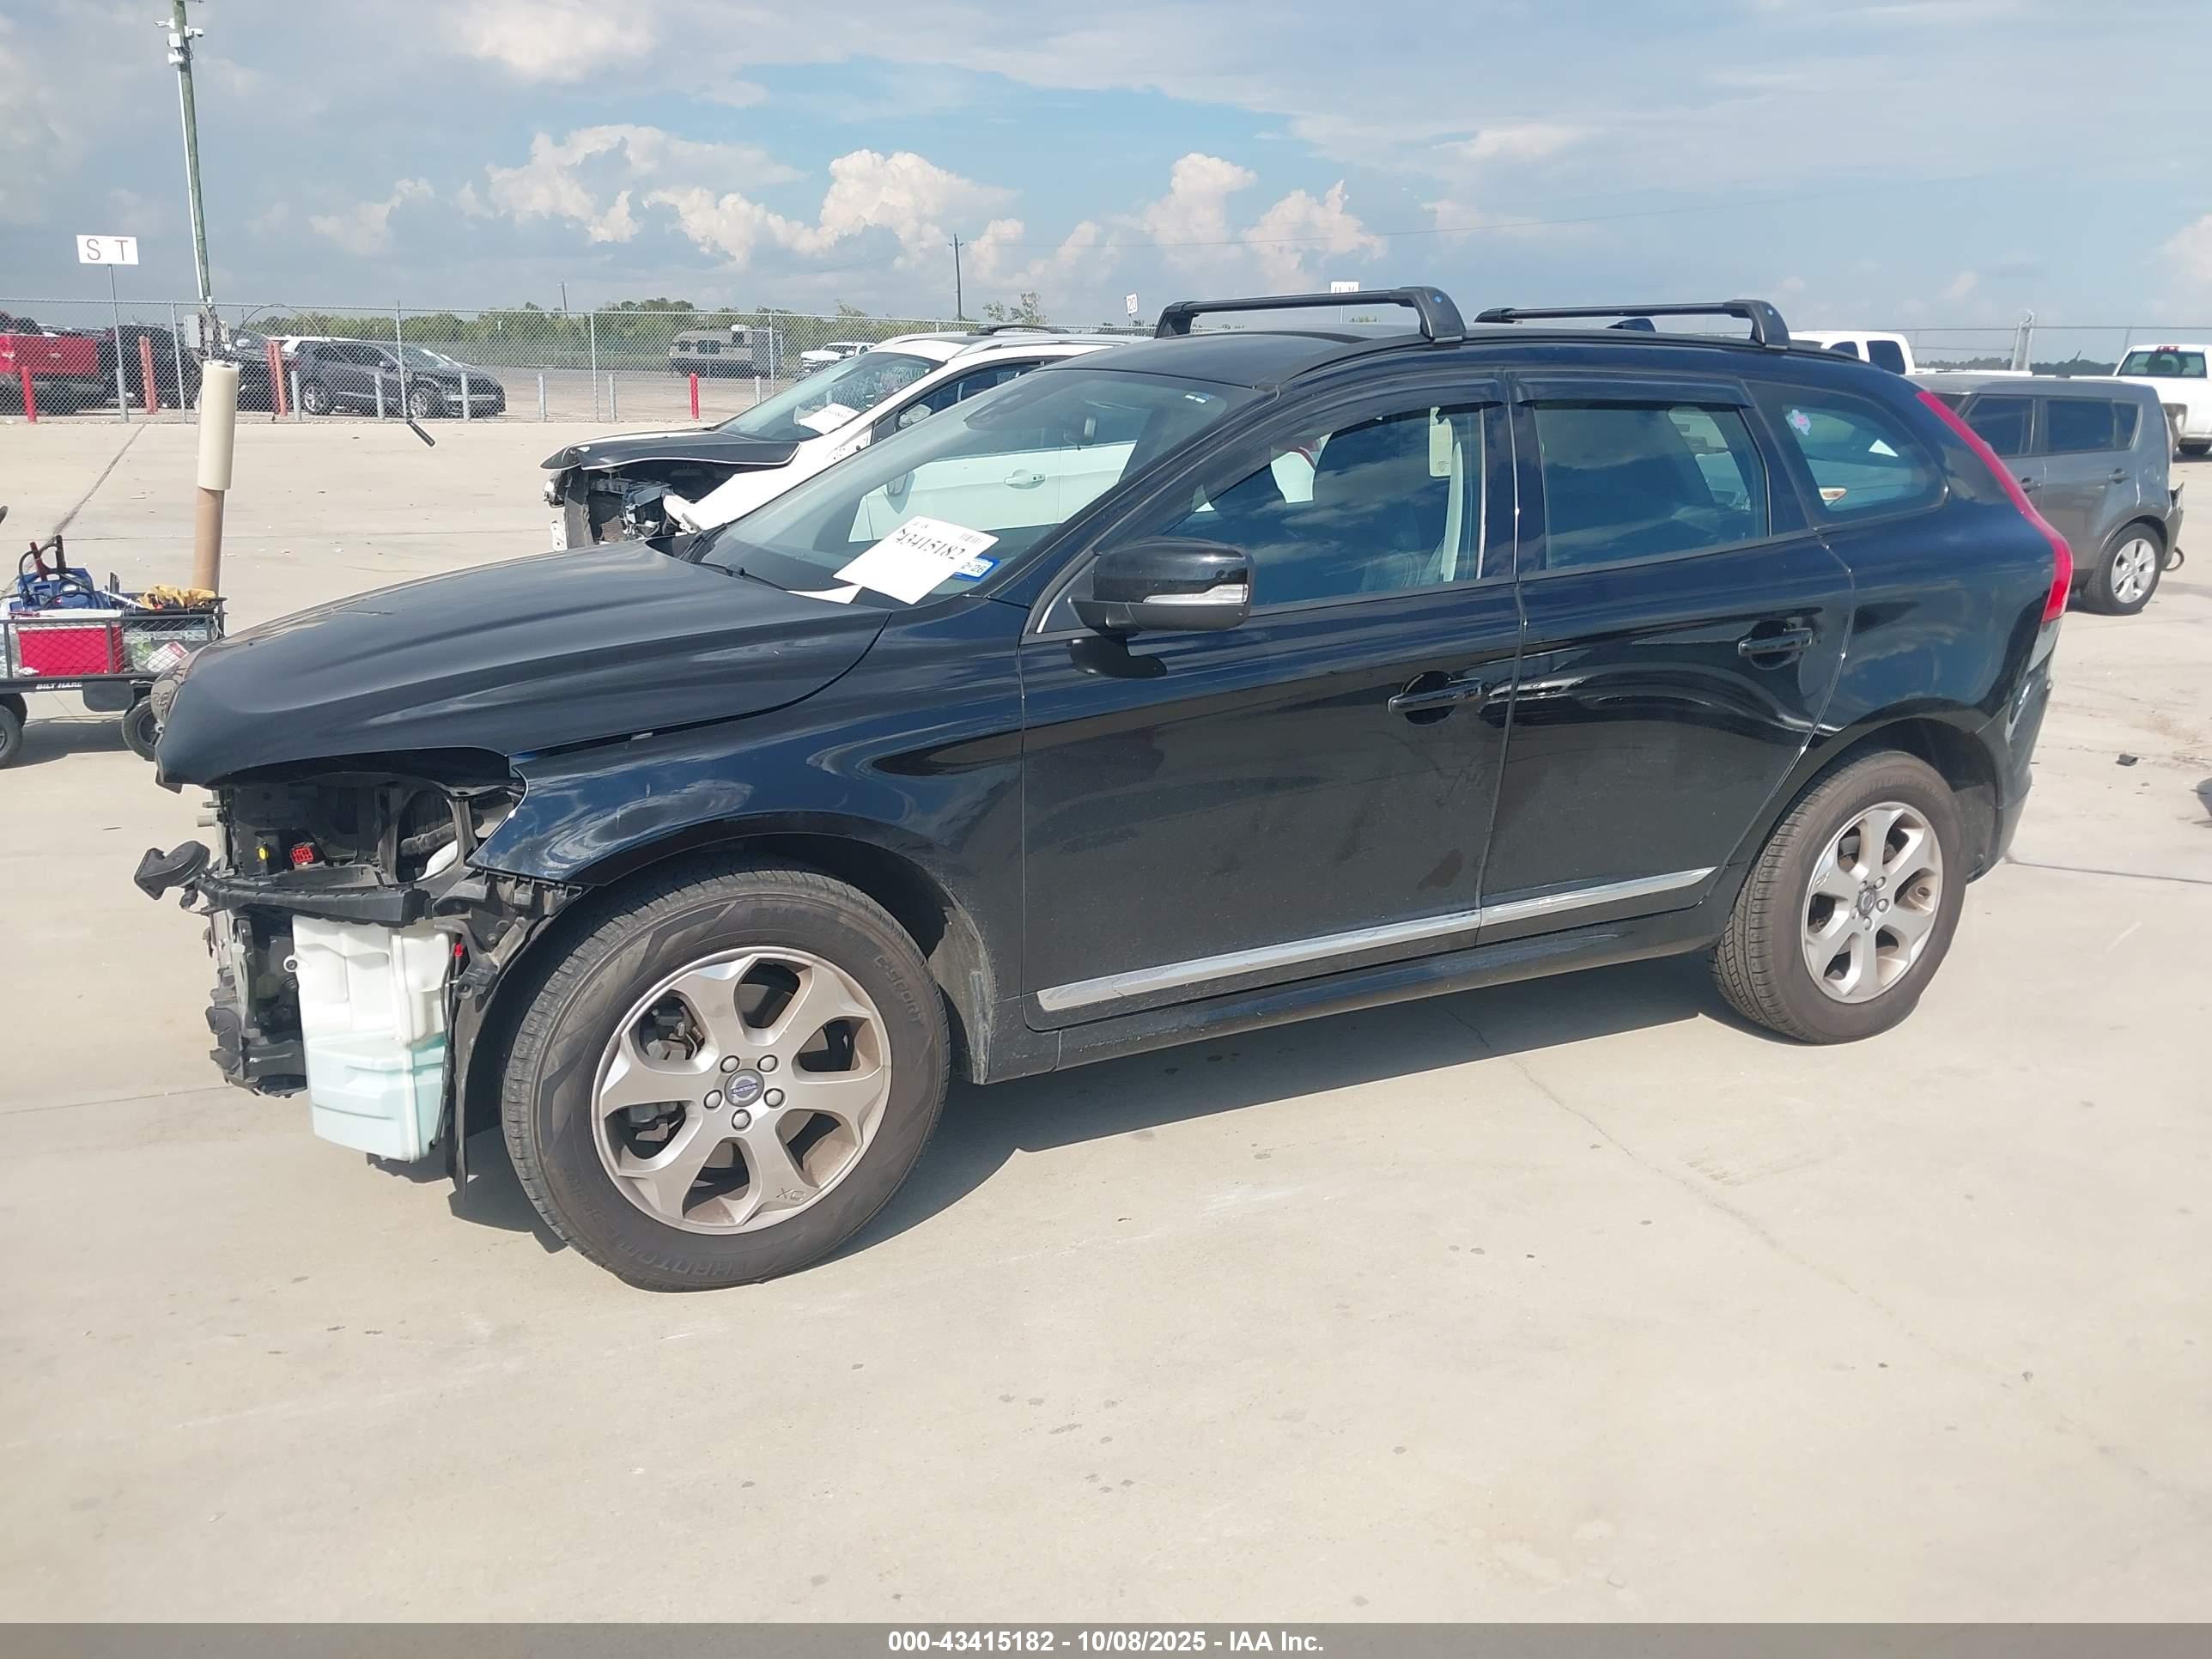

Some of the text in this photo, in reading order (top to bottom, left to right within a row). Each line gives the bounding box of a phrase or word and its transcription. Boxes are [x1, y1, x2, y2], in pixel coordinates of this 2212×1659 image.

[87, 238, 129, 262] S T
[1127, 296, 1137, 312] 20
[895, 527, 967, 560] 43415182
